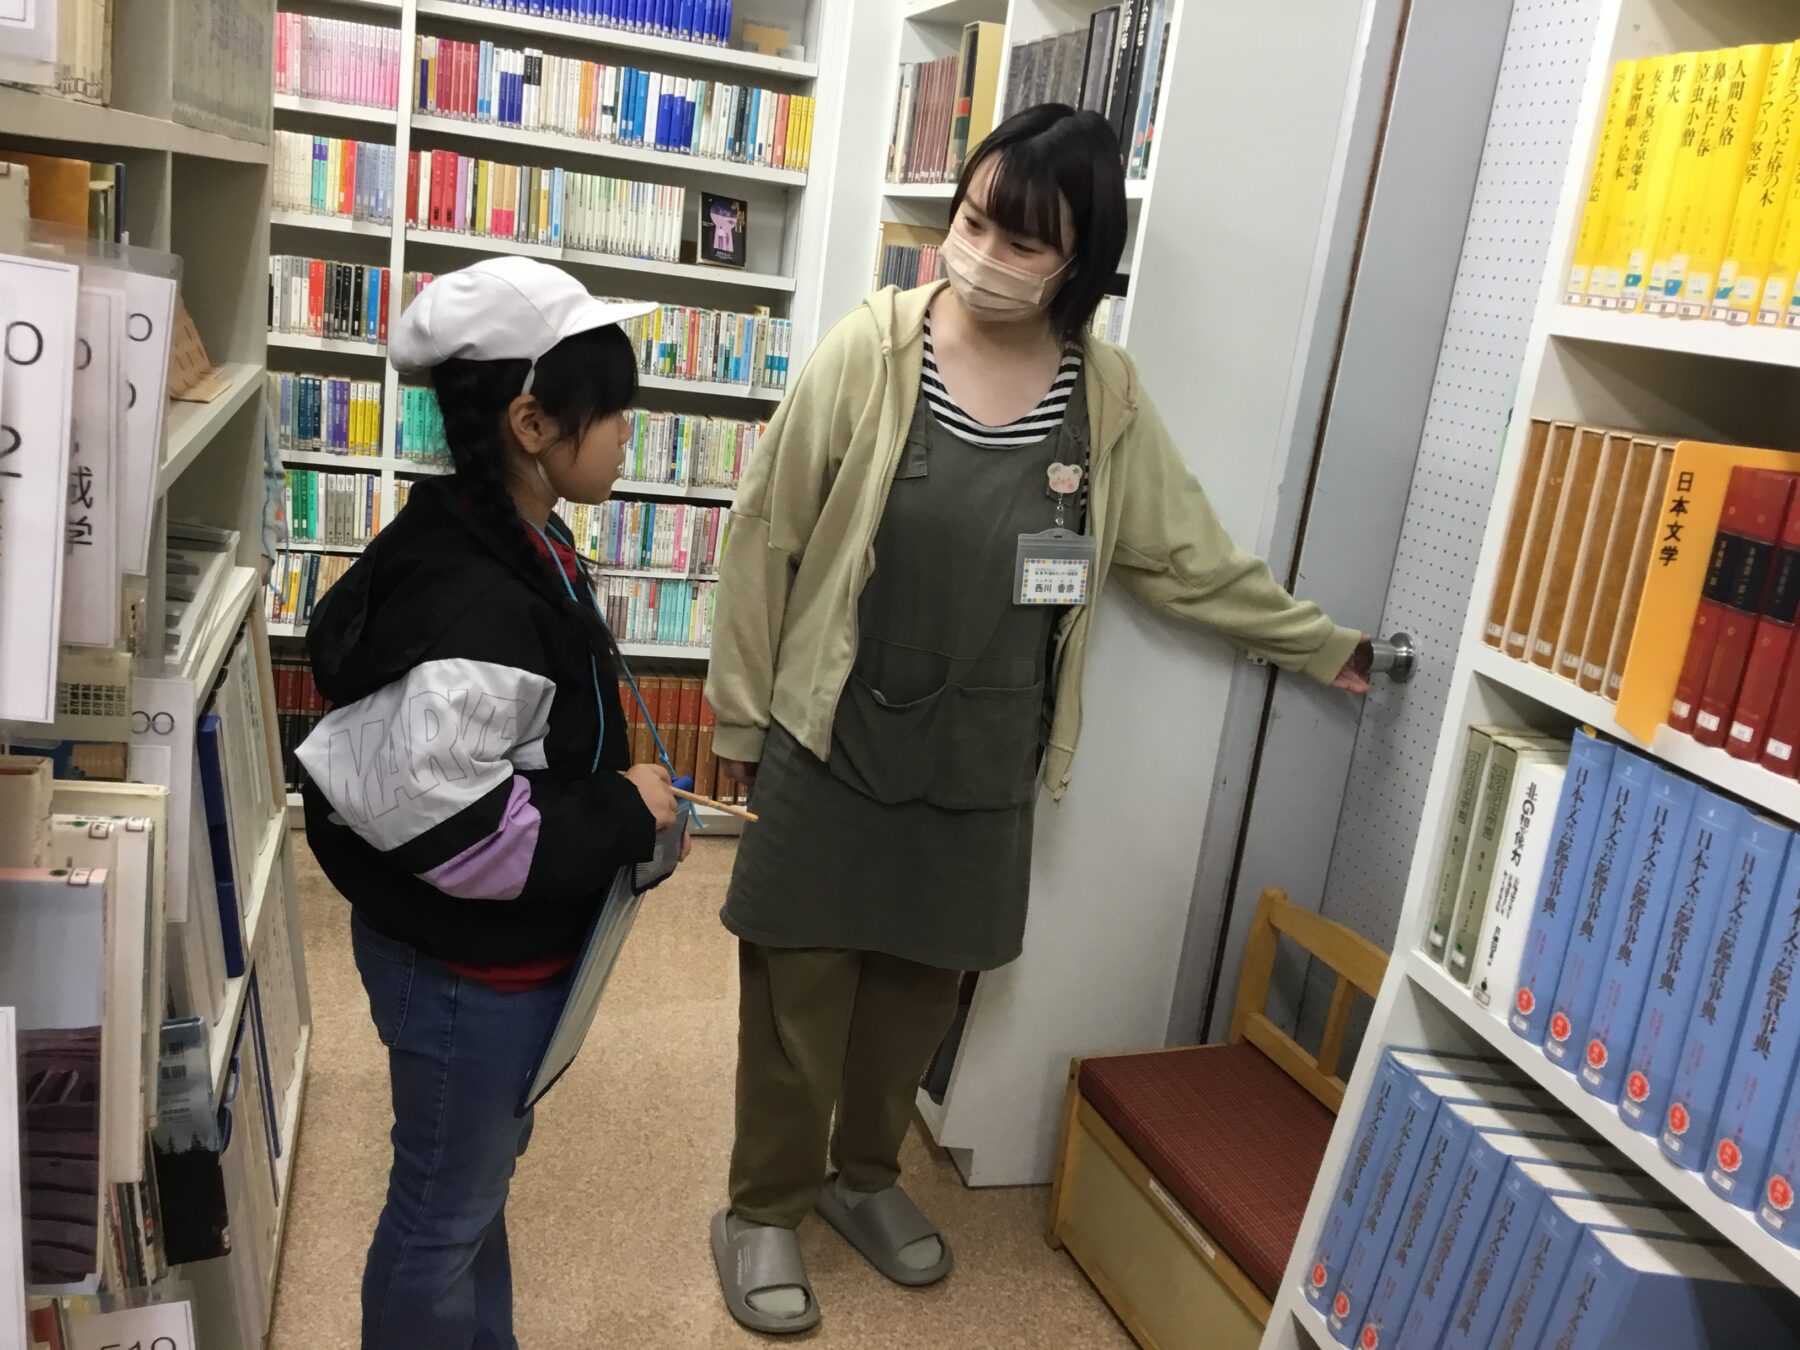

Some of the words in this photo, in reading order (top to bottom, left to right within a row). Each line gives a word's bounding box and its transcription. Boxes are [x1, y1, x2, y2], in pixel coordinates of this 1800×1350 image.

[1667, 63, 1687, 104] 野火
[1680, 63, 1710, 148] 泣虫小僧
[1696, 61, 1726, 157] 鼻・杜子春
[1718, 59, 1746, 146] 人間失格
[1745, 58, 1784, 183] ビルマの竪琴
[1659, 471, 1694, 566] 日本文学
[1035, 584, 1051, 593] 西川
[1058, 584, 1075, 593] 香奈
[328, 689, 528, 824] MARVE
[1542, 766, 1589, 918] 日本文芸鑑賞事典
[1578, 786, 1629, 943] 日本文芸鑑賞事典
[1617, 805, 1668, 967] 日本文芸鑑賞事典
[1657, 829, 1712, 997] 日本文芸鑑賞事典
[1699, 853, 1756, 1026] 日本文芸鑑賞事典
[1751, 888, 1800, 1061] 本文芸鑑賞事典
